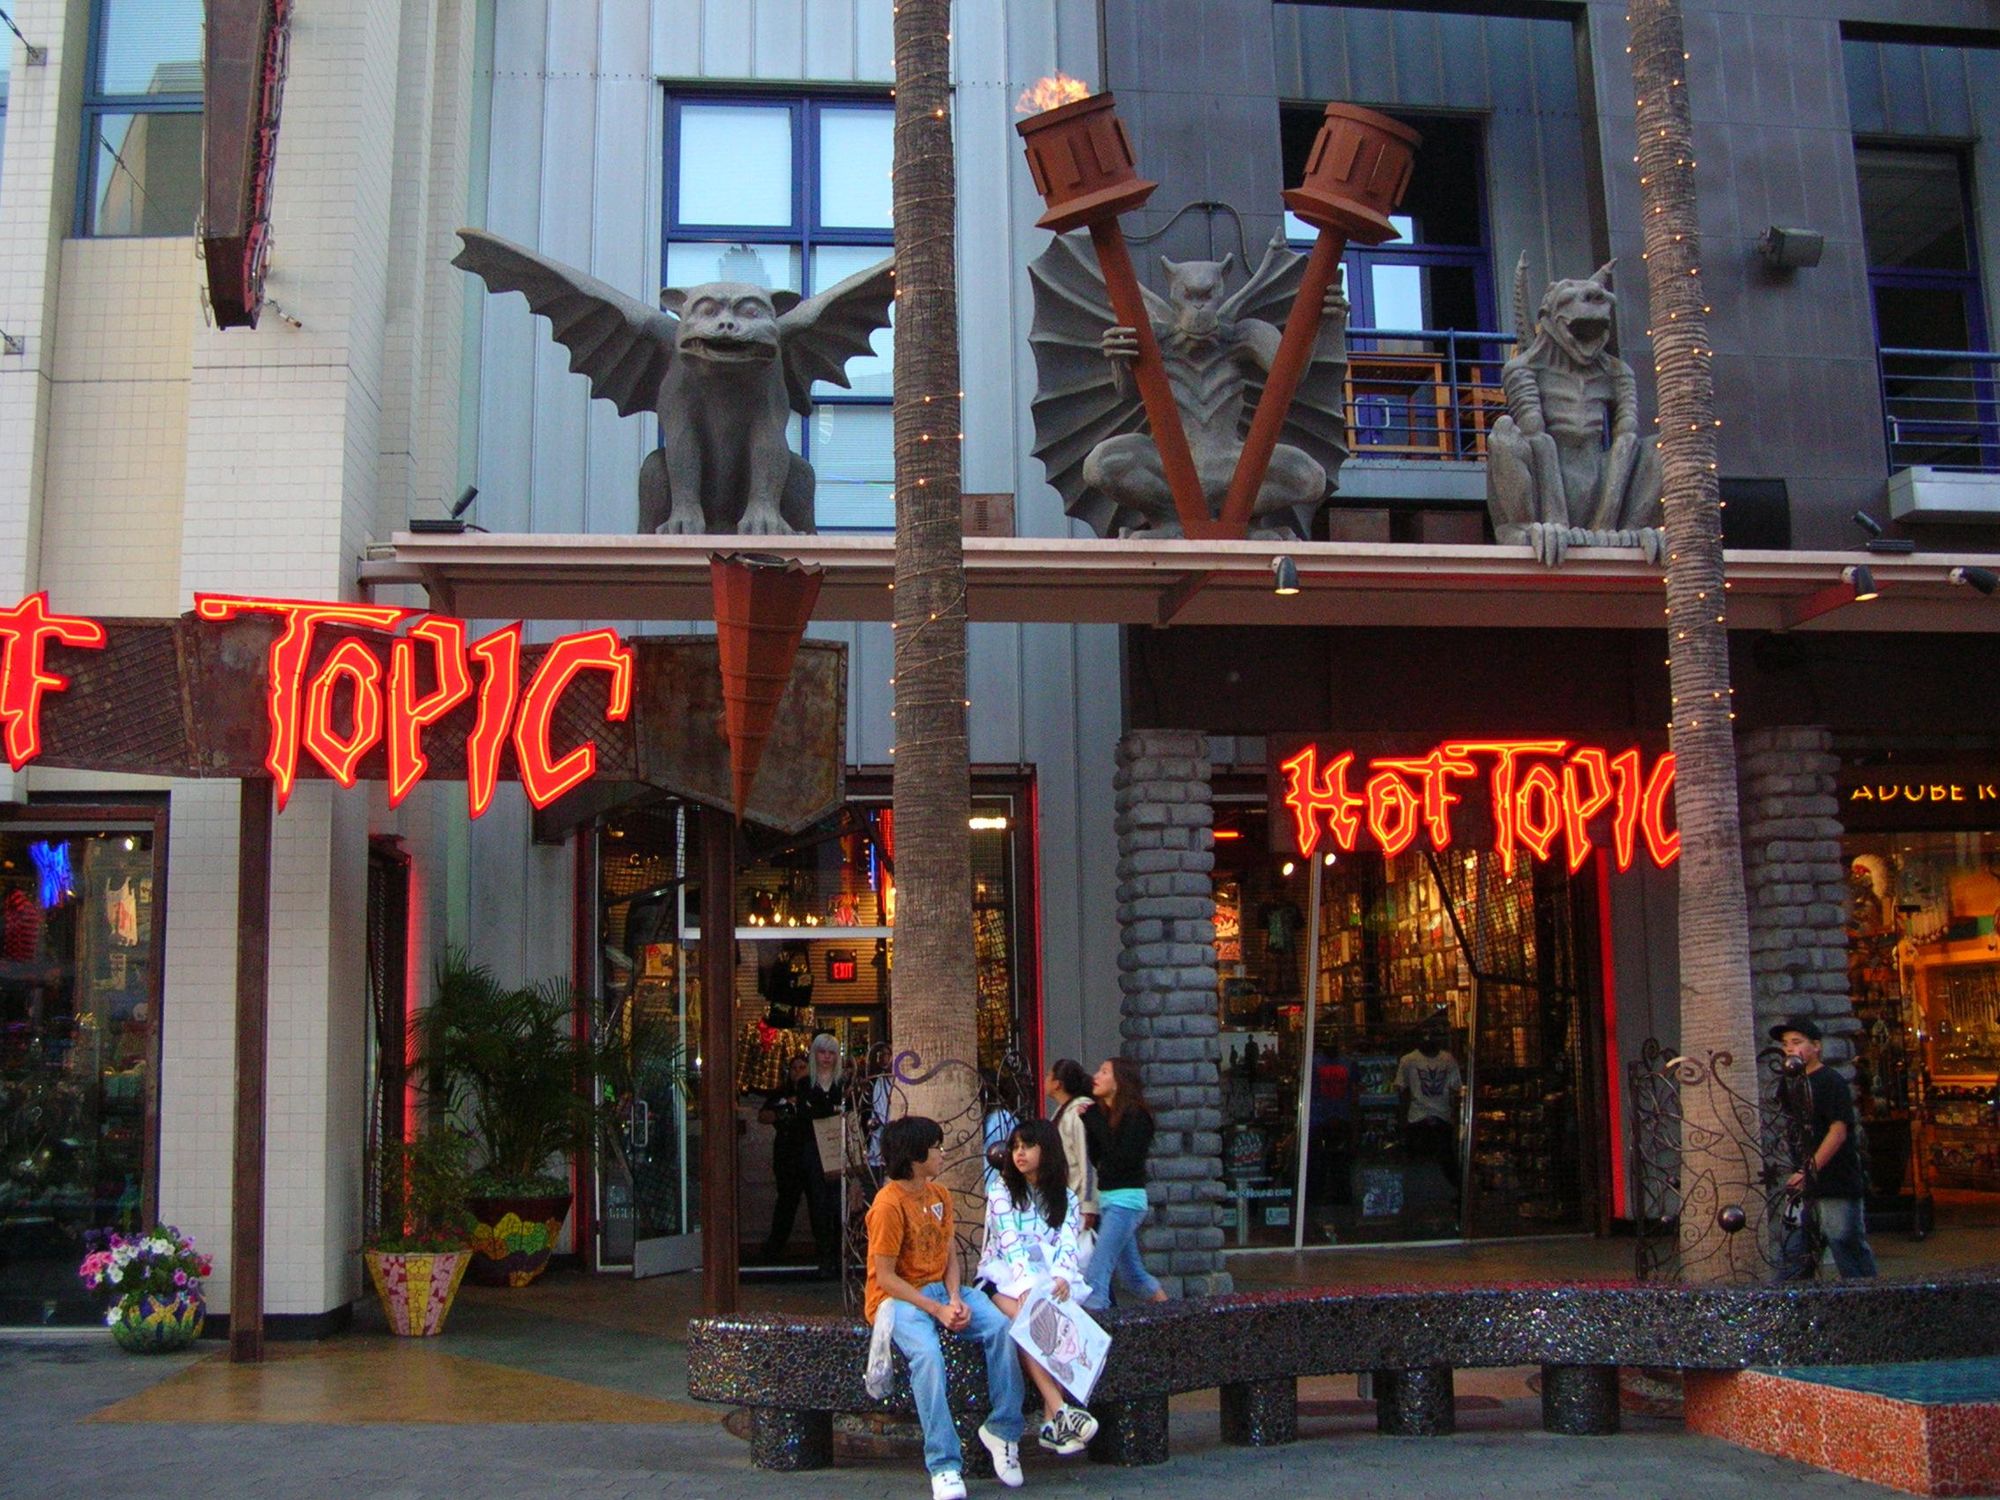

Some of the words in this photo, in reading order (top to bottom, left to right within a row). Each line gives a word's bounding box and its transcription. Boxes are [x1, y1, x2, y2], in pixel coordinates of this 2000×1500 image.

[194, 591, 633, 819] TOPIC
[1281, 743, 1477, 858] HOT
[833, 962, 854, 979] EXIT
